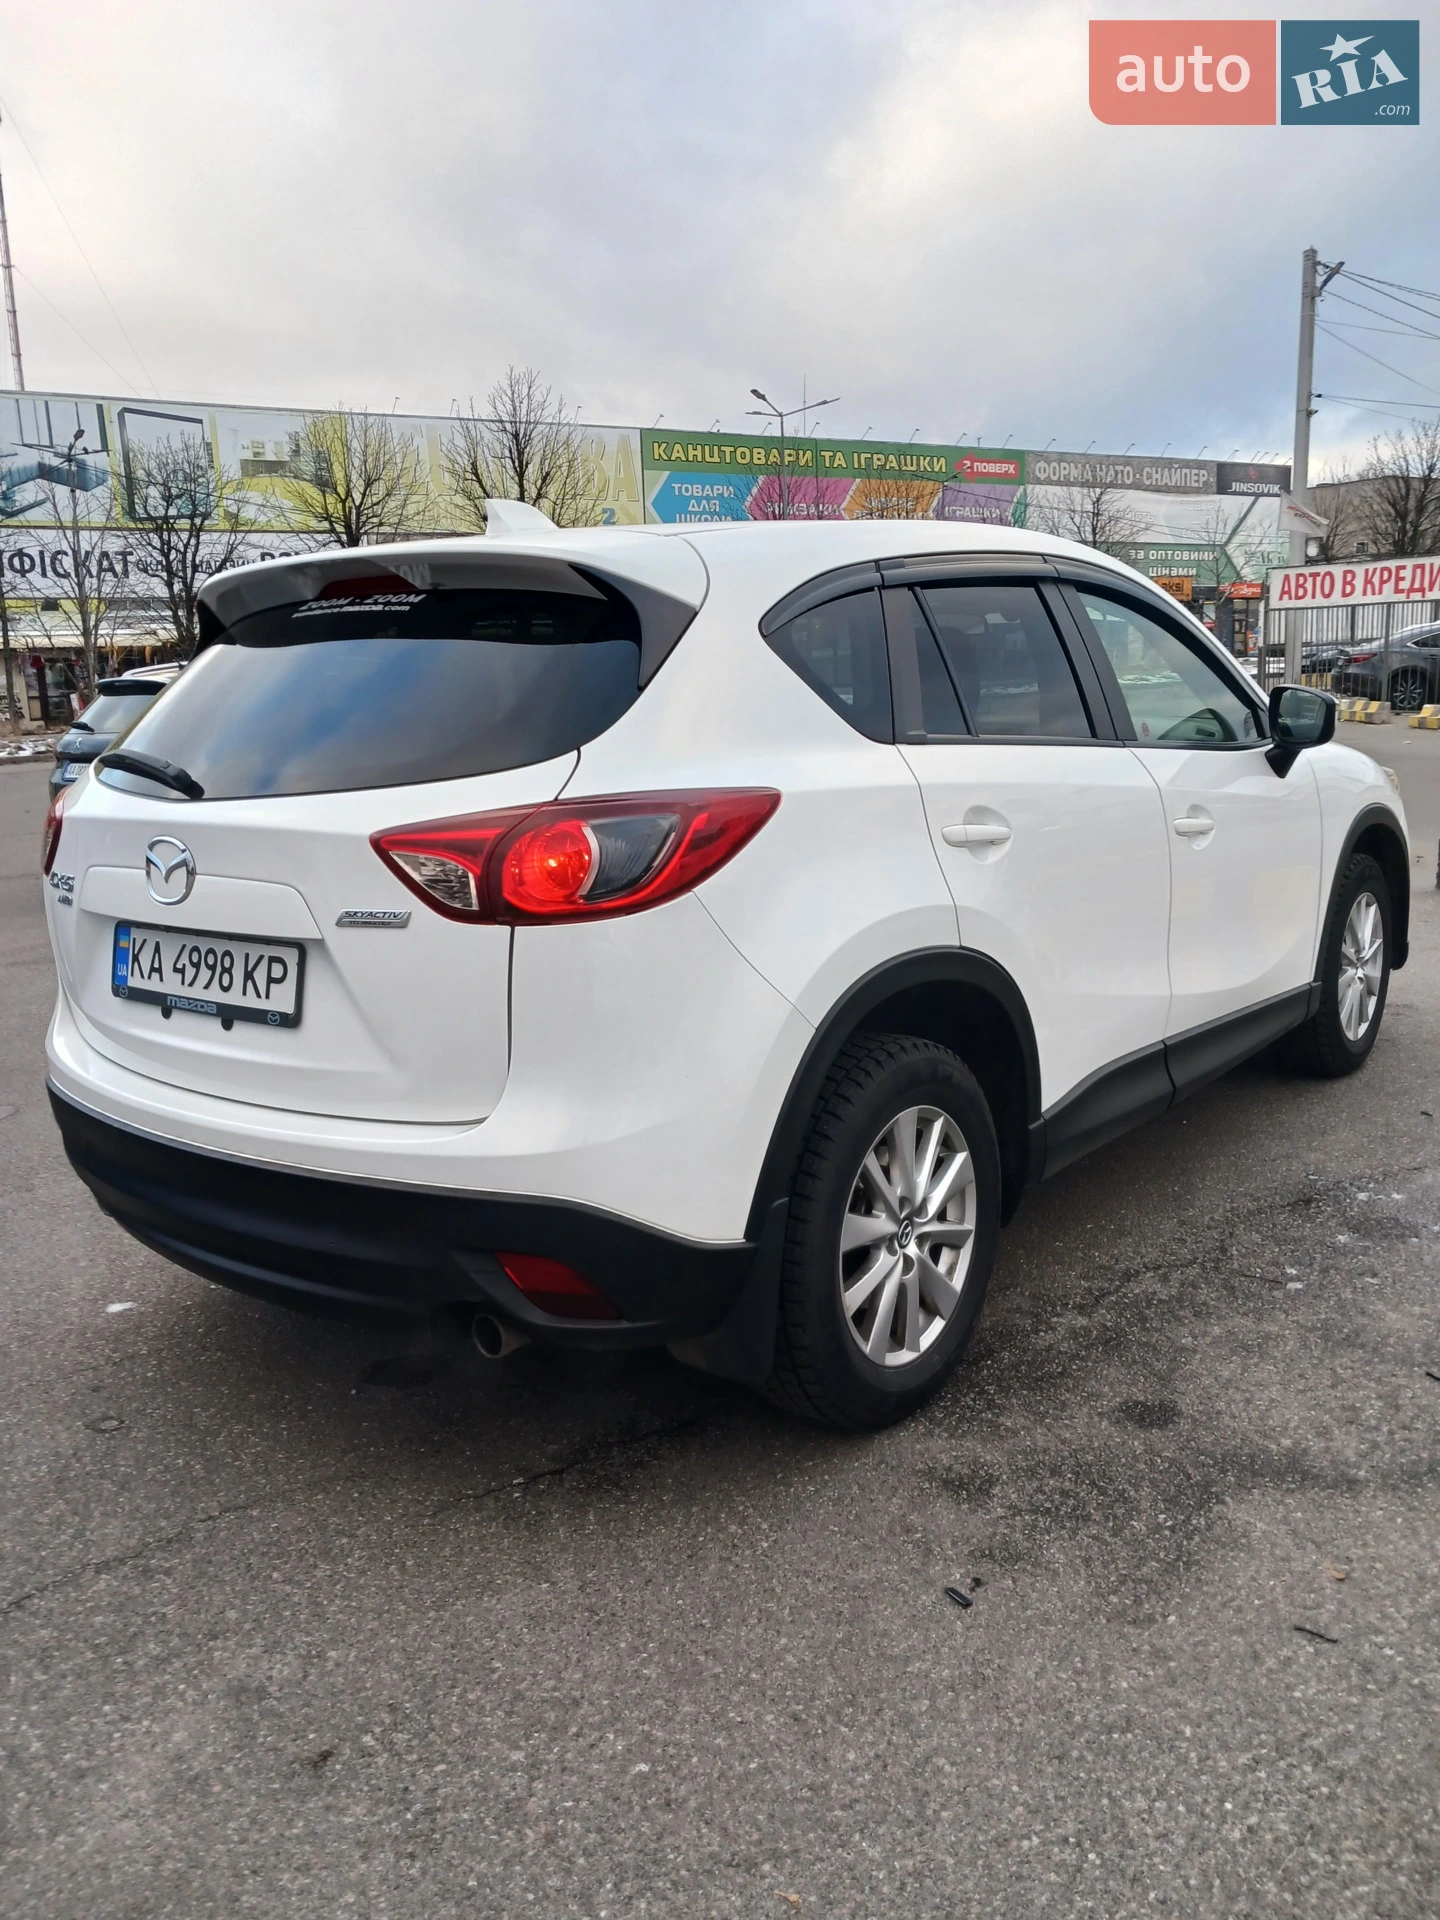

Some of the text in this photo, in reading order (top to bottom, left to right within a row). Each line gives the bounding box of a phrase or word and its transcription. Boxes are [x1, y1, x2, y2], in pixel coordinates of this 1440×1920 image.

[653, 442, 948, 473] КАНЦТОВАРИ ТА ІГРАШКИ
[973, 461, 1016, 474] ПОВЕРХ
[1035, 460, 1210, 488] ФОРМА НАТО СНАЙПЕР
[671, 483, 735, 497] ТОВАРИ
[1227, 481, 1281, 494] JINSOVIK
[687, 499, 720, 512] ДЛЯ
[944, 505, 1001, 519] ІГРАШКИ
[1128, 549, 1218, 561] за оптовими
[1148, 565, 1198, 578] цінами
[1278, 571, 1336, 602] АВТО
[1340, 569, 1357, 599] В
[298, 596, 355, 611] ZOOM
[363, 593, 428, 603] ZOOM
[342, 910, 404, 919] SKYACTIV
[117, 962, 128, 977] UA
[130, 937, 289, 1000] KA 4998 KP
[167, 995, 218, 1014] mazda
